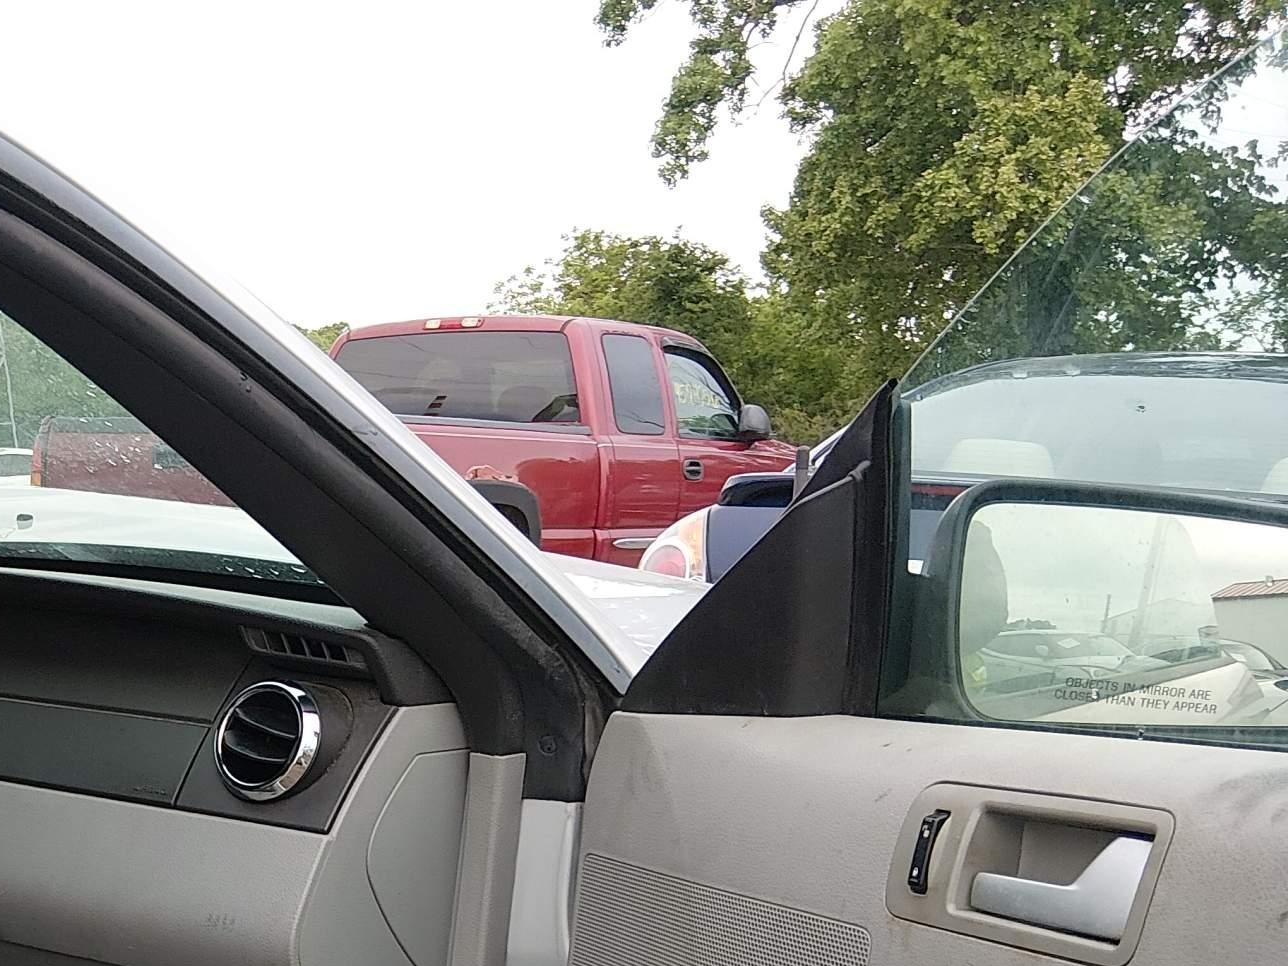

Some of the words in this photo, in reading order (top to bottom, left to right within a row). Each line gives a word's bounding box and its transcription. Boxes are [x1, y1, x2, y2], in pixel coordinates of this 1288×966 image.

[1065, 677, 1119, 691] OBJECTS
[1123, 685, 1136, 695] IN
[1141, 685, 1186, 699] MIRROR
[1188, 690, 1212, 701] ARE
[1105, 694, 1136, 707] THAN
[1140, 697, 1171, 711] THEY
[1172, 701, 1217, 714] APPEAR
